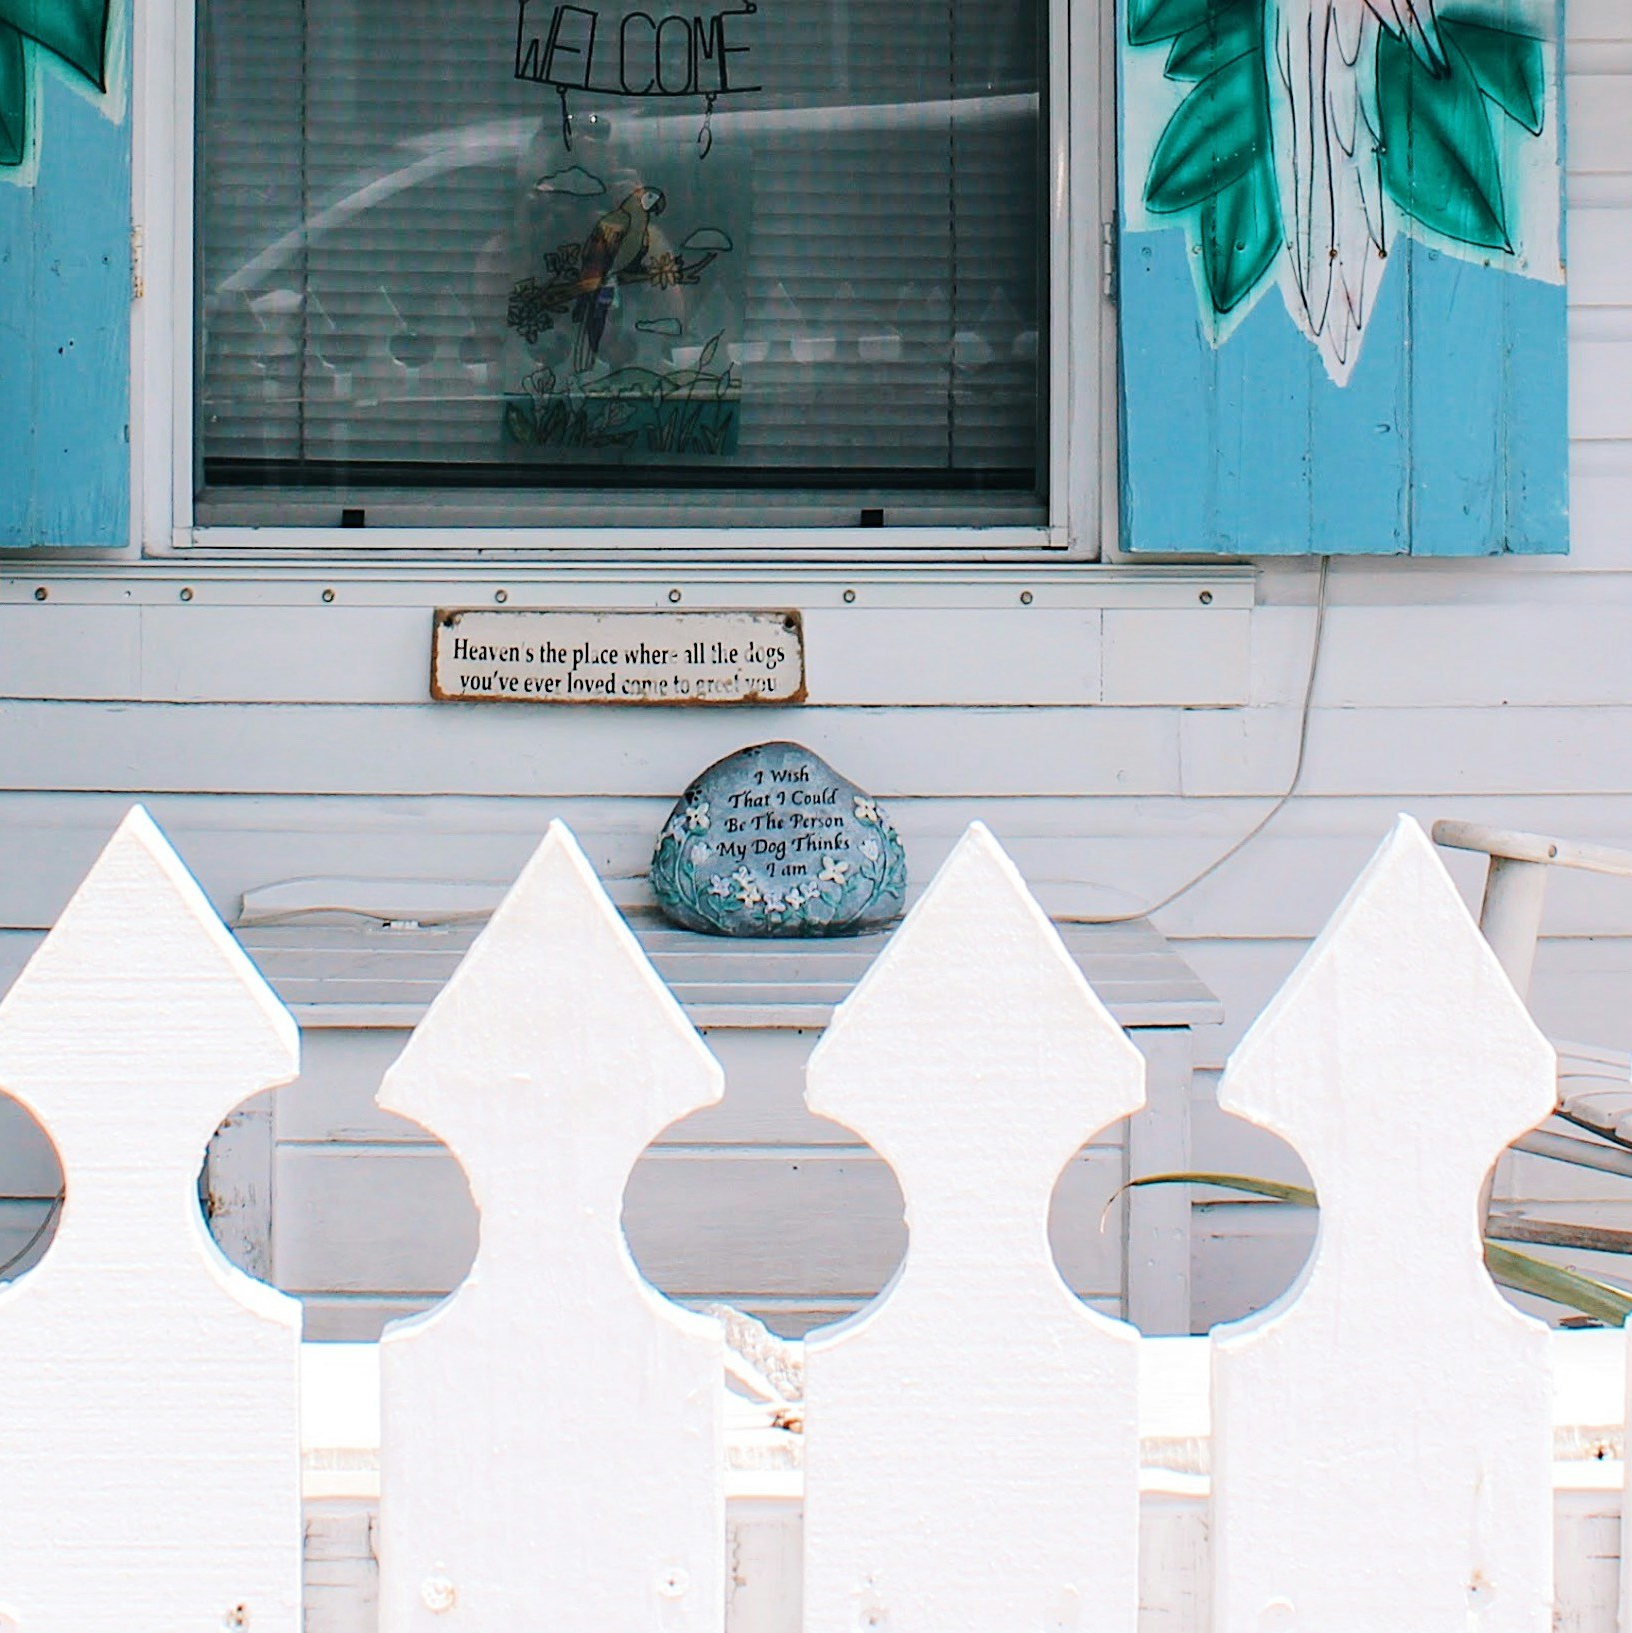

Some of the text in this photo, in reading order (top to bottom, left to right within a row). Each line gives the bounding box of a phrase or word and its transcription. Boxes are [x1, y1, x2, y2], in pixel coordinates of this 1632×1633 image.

[514, 2, 763, 97] WELCOME
[453, 637, 535, 663] Heaven's
[539, 640, 567, 664] the
[572, 641, 618, 671] place
[684, 642, 705, 665] all
[744, 641, 785, 670] dogs
[460, 670, 519, 696] you've
[523, 677, 562, 695] ever
[567, 671, 616, 695] loved
[673, 674, 690, 695] to
[753, 764, 810, 785] I Wish
[728, 787, 839, 809] That I Could
[724, 811, 845, 834] Be The Person
[715, 833, 851, 863] My Dog Thinks
[766, 862, 808, 879] I am
